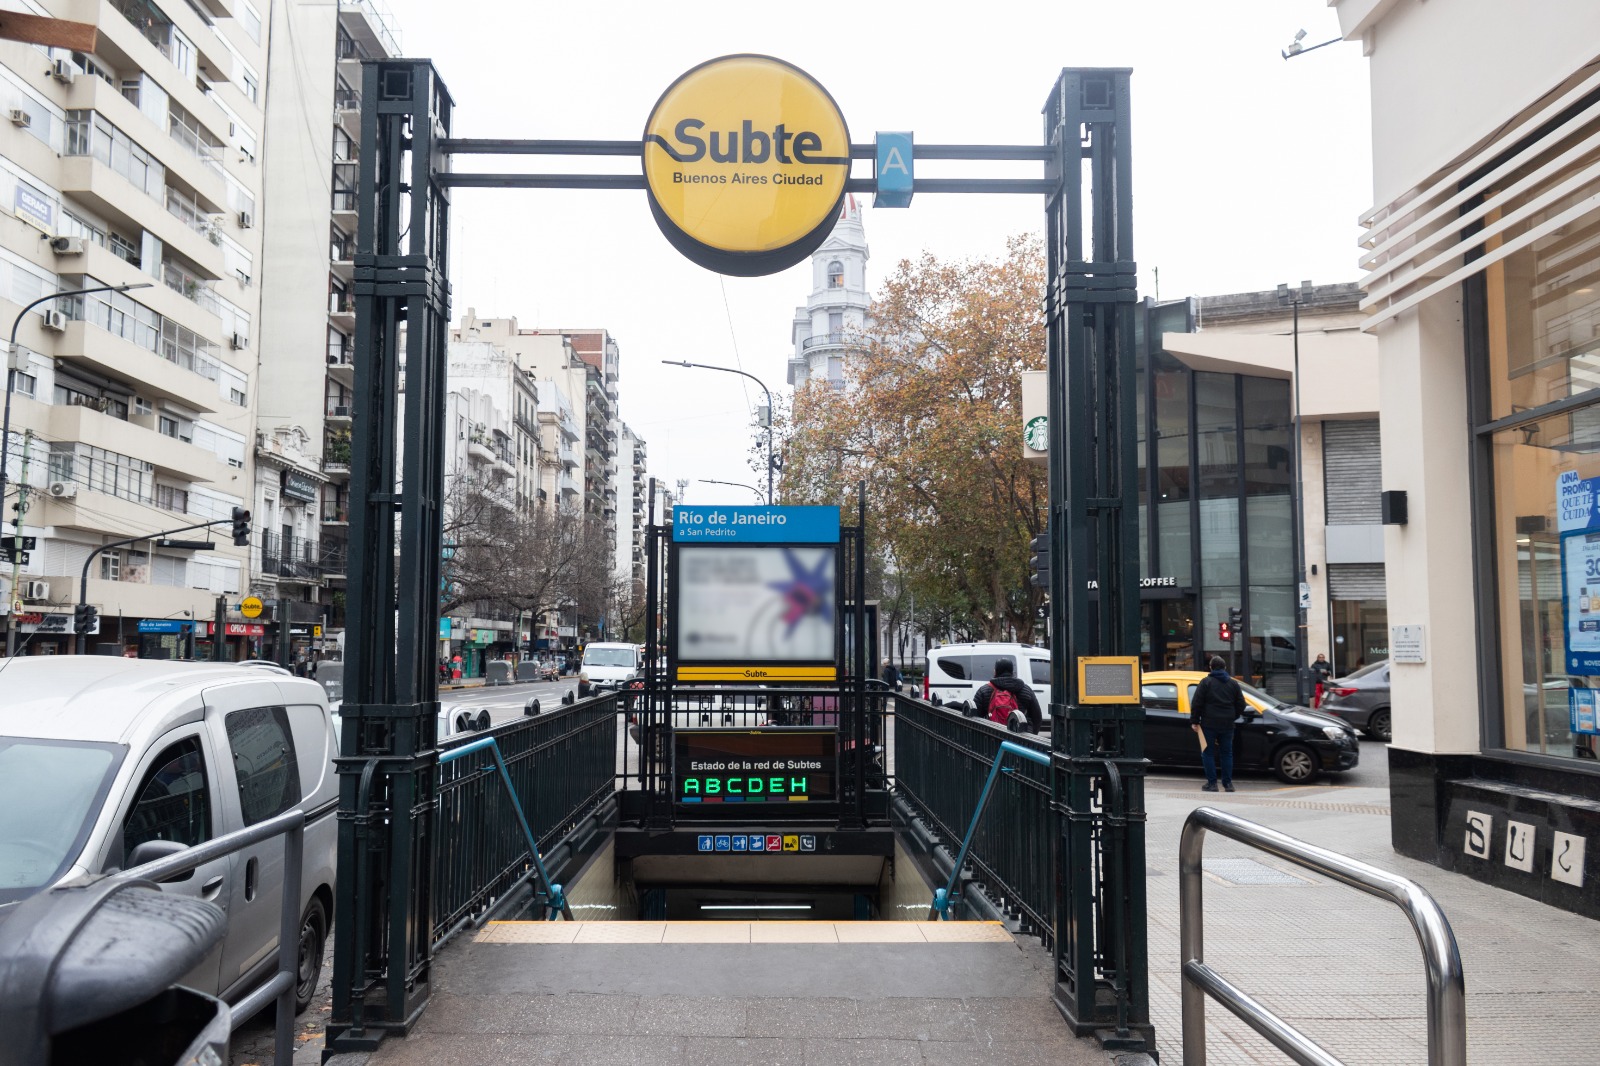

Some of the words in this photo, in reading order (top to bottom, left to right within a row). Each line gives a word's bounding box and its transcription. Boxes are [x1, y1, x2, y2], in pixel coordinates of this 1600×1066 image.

[673, 118, 823, 165] Subte
[880, 147, 909, 175] A
[673, 172, 727, 184] Buenos
[731, 172, 768, 185] Aires
[772, 173, 823, 186] Ciudad
[1562, 472, 1578, 484] UNA
[1563, 481, 1591, 496] PROMO
[1562, 496, 1580, 510] QUE
[679, 510, 703, 525] Río
[708, 511, 727, 525] de
[732, 511, 787, 525] Janeiro
[1563, 507, 1590, 520] CUIDA
[687, 528, 703, 536] San
[705, 528, 736, 537] Pedrito
[745, 670, 768, 678] Subte
[691, 760, 726, 770] Estado
[728, 760, 740, 770] de
[742, 760, 752, 770] la
[754, 760, 770, 770] red
[772, 760, 785, 770] de
[788, 760, 822, 770] Subtes
